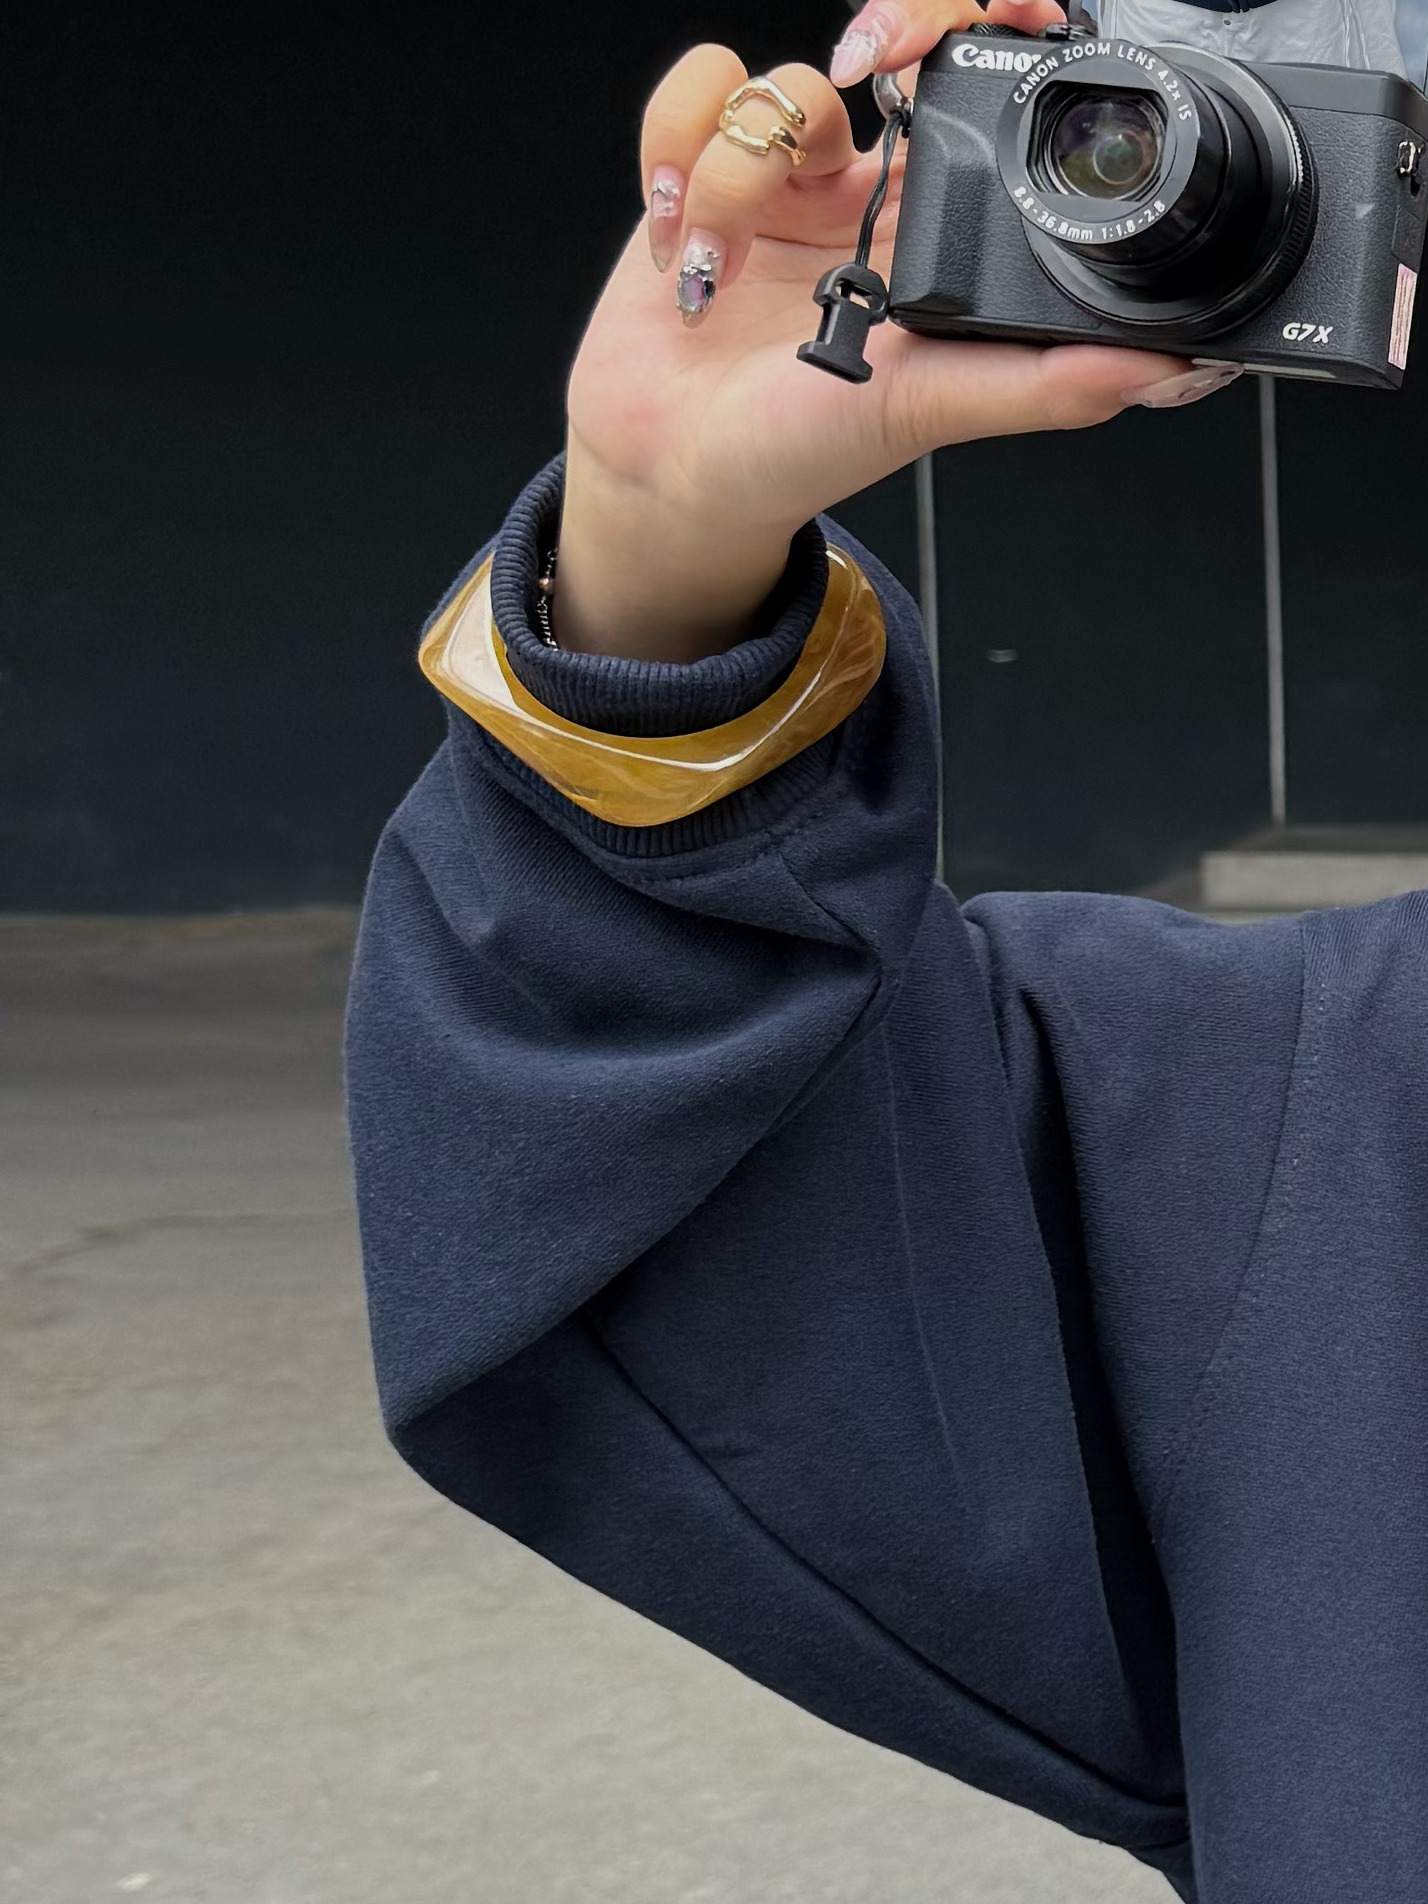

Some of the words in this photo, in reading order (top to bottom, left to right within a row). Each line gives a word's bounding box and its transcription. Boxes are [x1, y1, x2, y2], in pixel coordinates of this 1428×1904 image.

[952, 44, 1042, 73] Cano
[1013, 56, 1059, 104] CANON
[1062, 42, 1111, 63] ZOOM
[1117, 44, 1156, 71] LENS
[1157, 69, 1181, 101] 4.2x
[1177, 103, 1192, 121] IS
[1282, 322, 1334, 344] G7X
